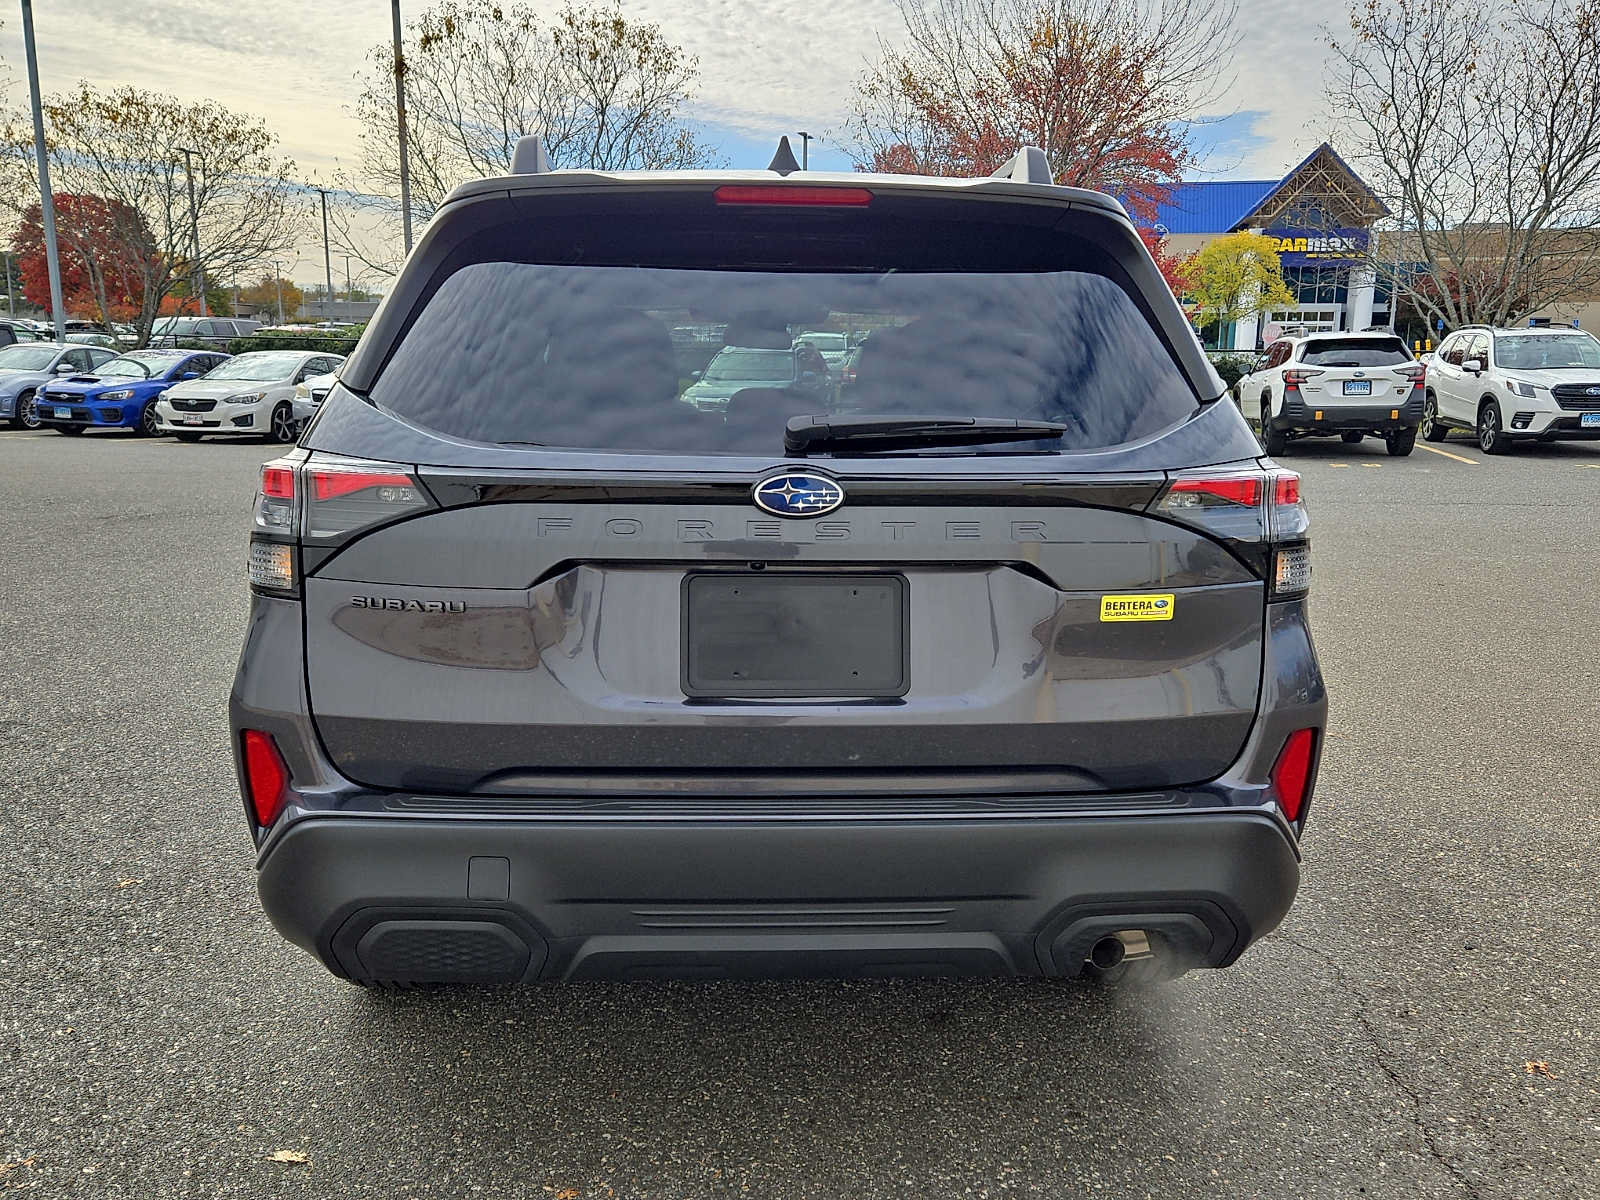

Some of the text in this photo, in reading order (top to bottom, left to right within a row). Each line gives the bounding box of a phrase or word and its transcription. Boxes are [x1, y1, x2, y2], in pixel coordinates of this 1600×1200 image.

[537, 517, 1048, 542] FORESTER
[351, 596, 466, 613] SUBARU
[1105, 601, 1152, 610] BERTERA
